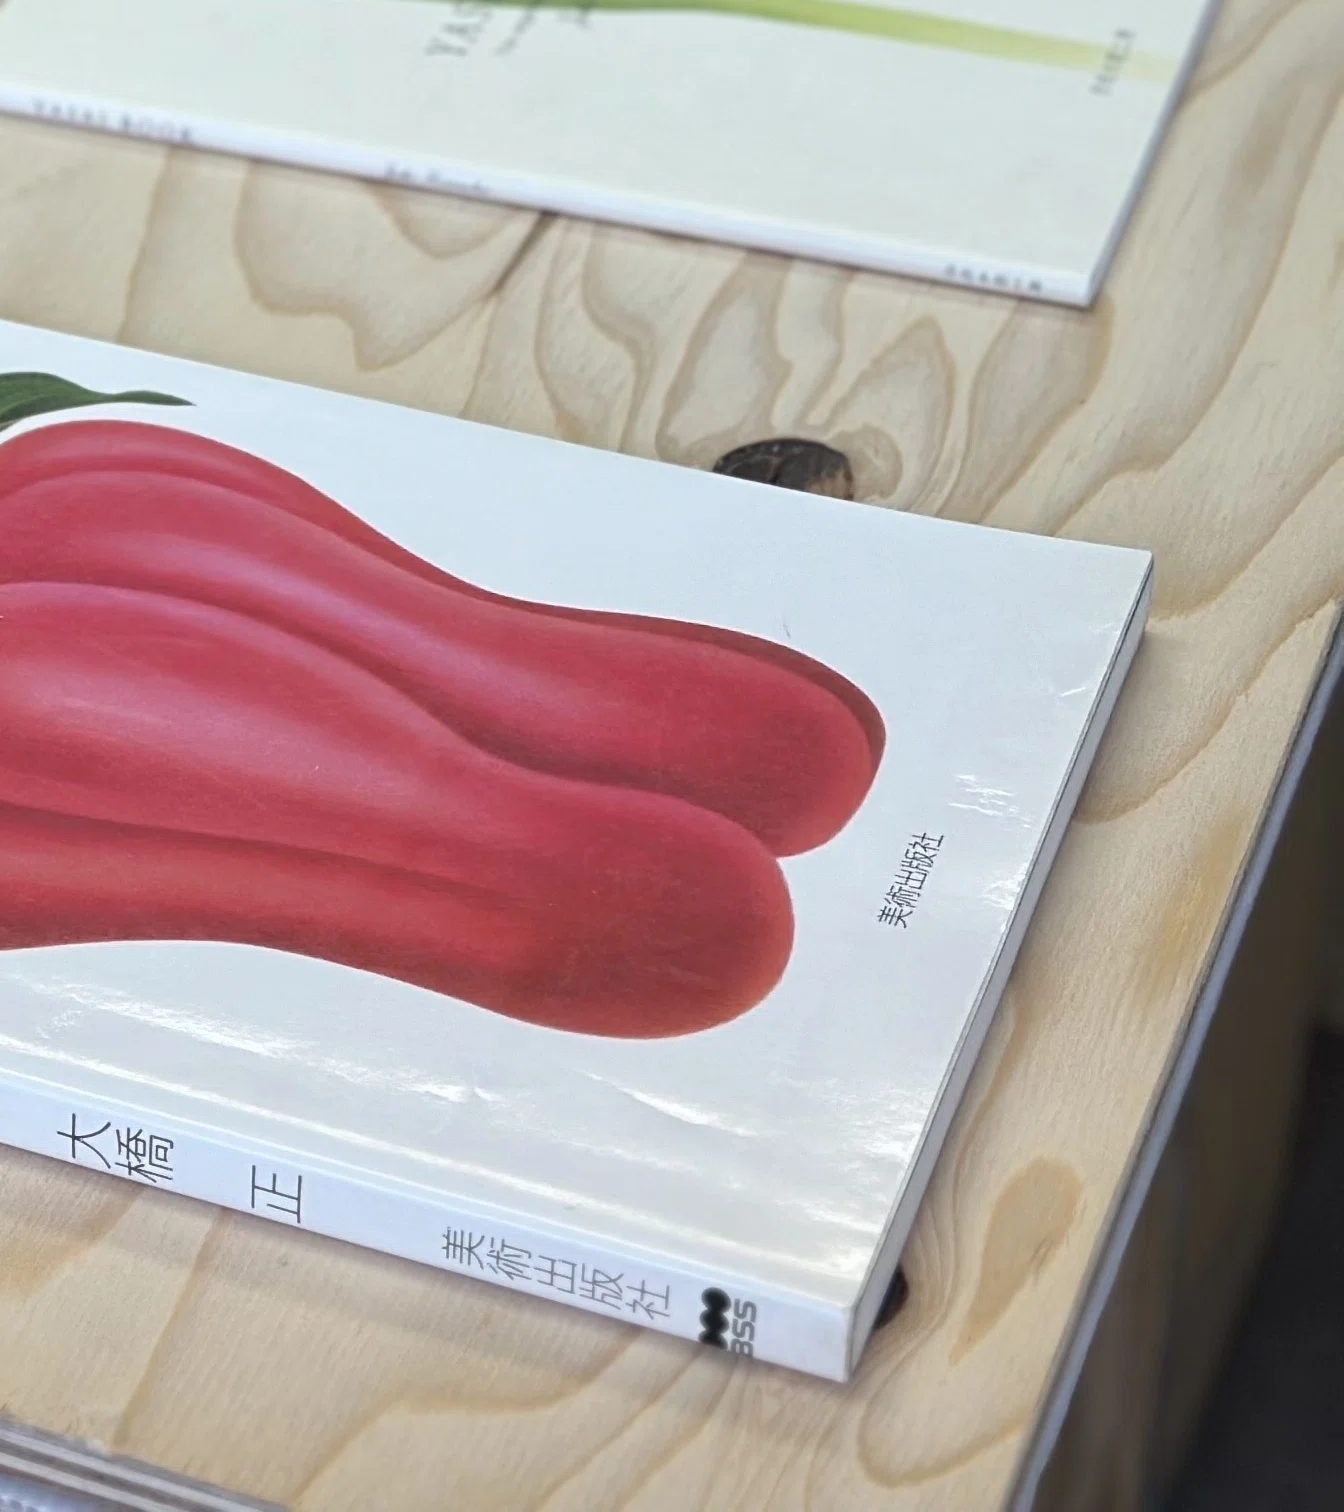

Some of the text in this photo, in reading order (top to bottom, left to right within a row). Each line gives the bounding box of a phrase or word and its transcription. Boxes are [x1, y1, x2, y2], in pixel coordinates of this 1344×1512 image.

[877, 832, 944, 929] 美術出版社
[56, 1112, 306, 1225] 大橋 正
[442, 1227, 671, 1321] 美術出版社
